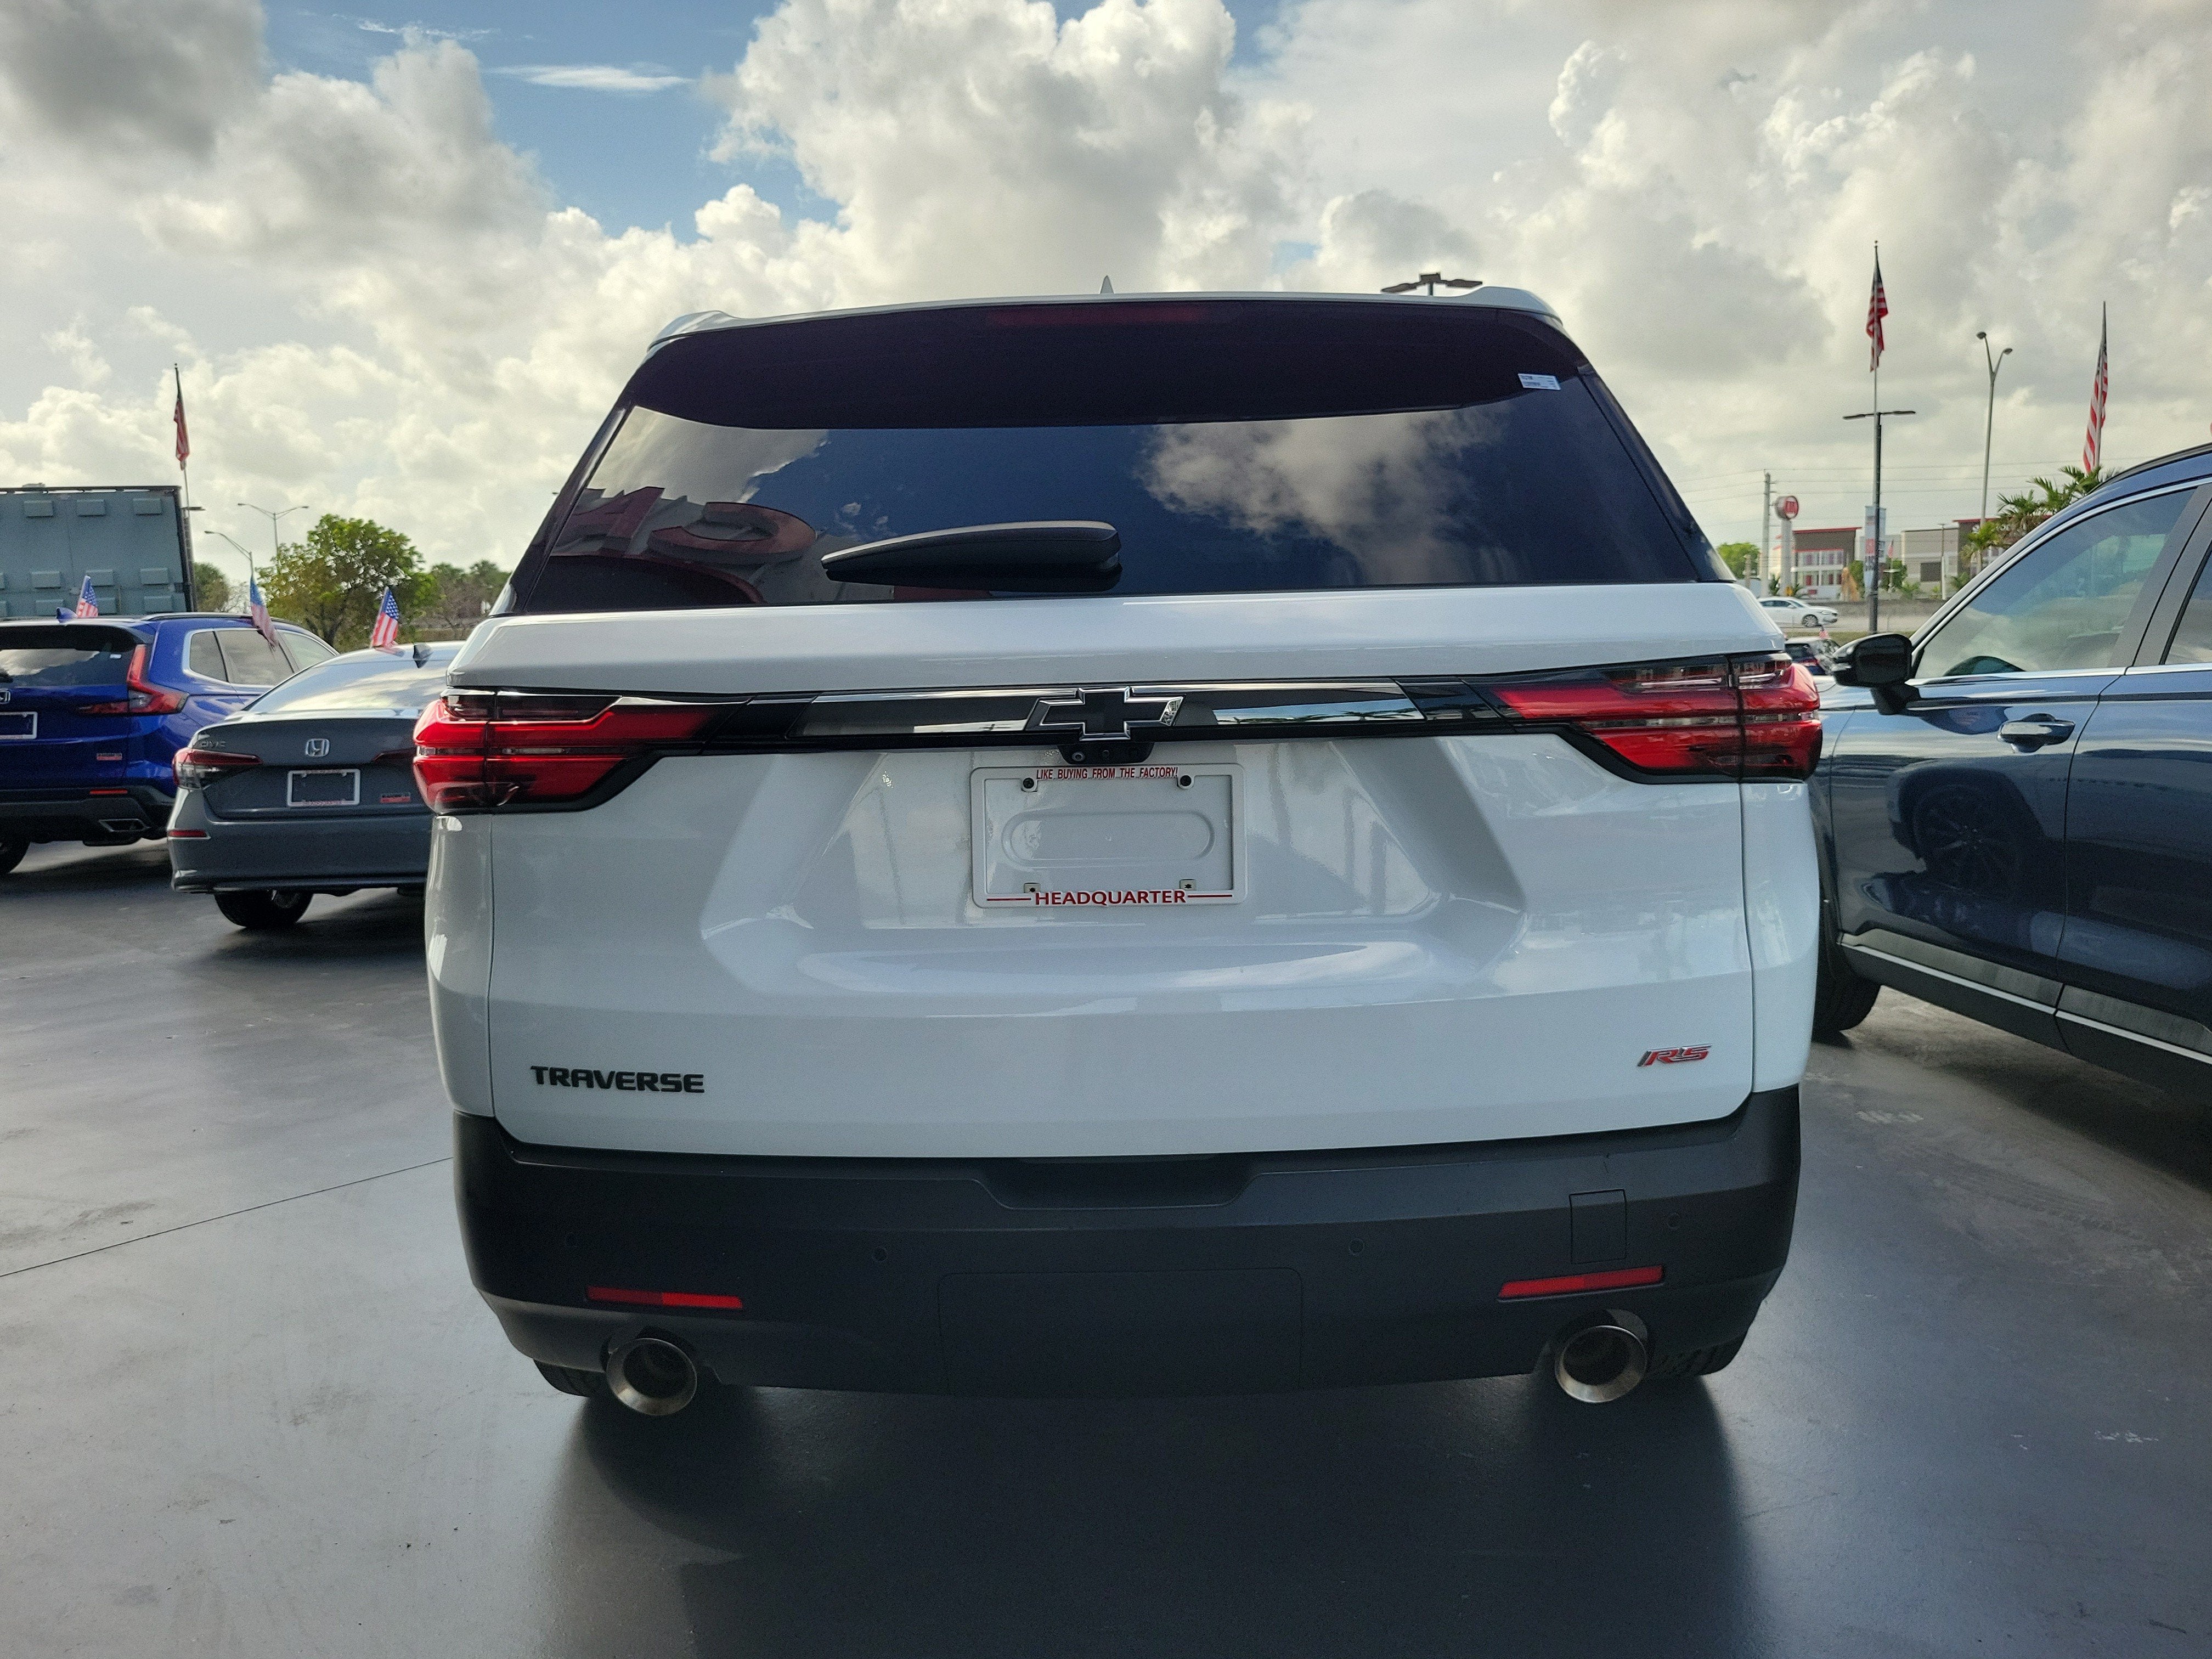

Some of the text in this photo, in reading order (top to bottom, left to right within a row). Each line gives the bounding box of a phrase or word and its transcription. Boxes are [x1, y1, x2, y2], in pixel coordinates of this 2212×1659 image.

[1036, 767, 1178, 779] LIKE BUYING FROM THE FACTORY!
[1035, 890, 1186, 906] HEADQUARTER
[1637, 1043, 1712, 1066] RS
[531, 1065, 704, 1093] TRAVERSE
